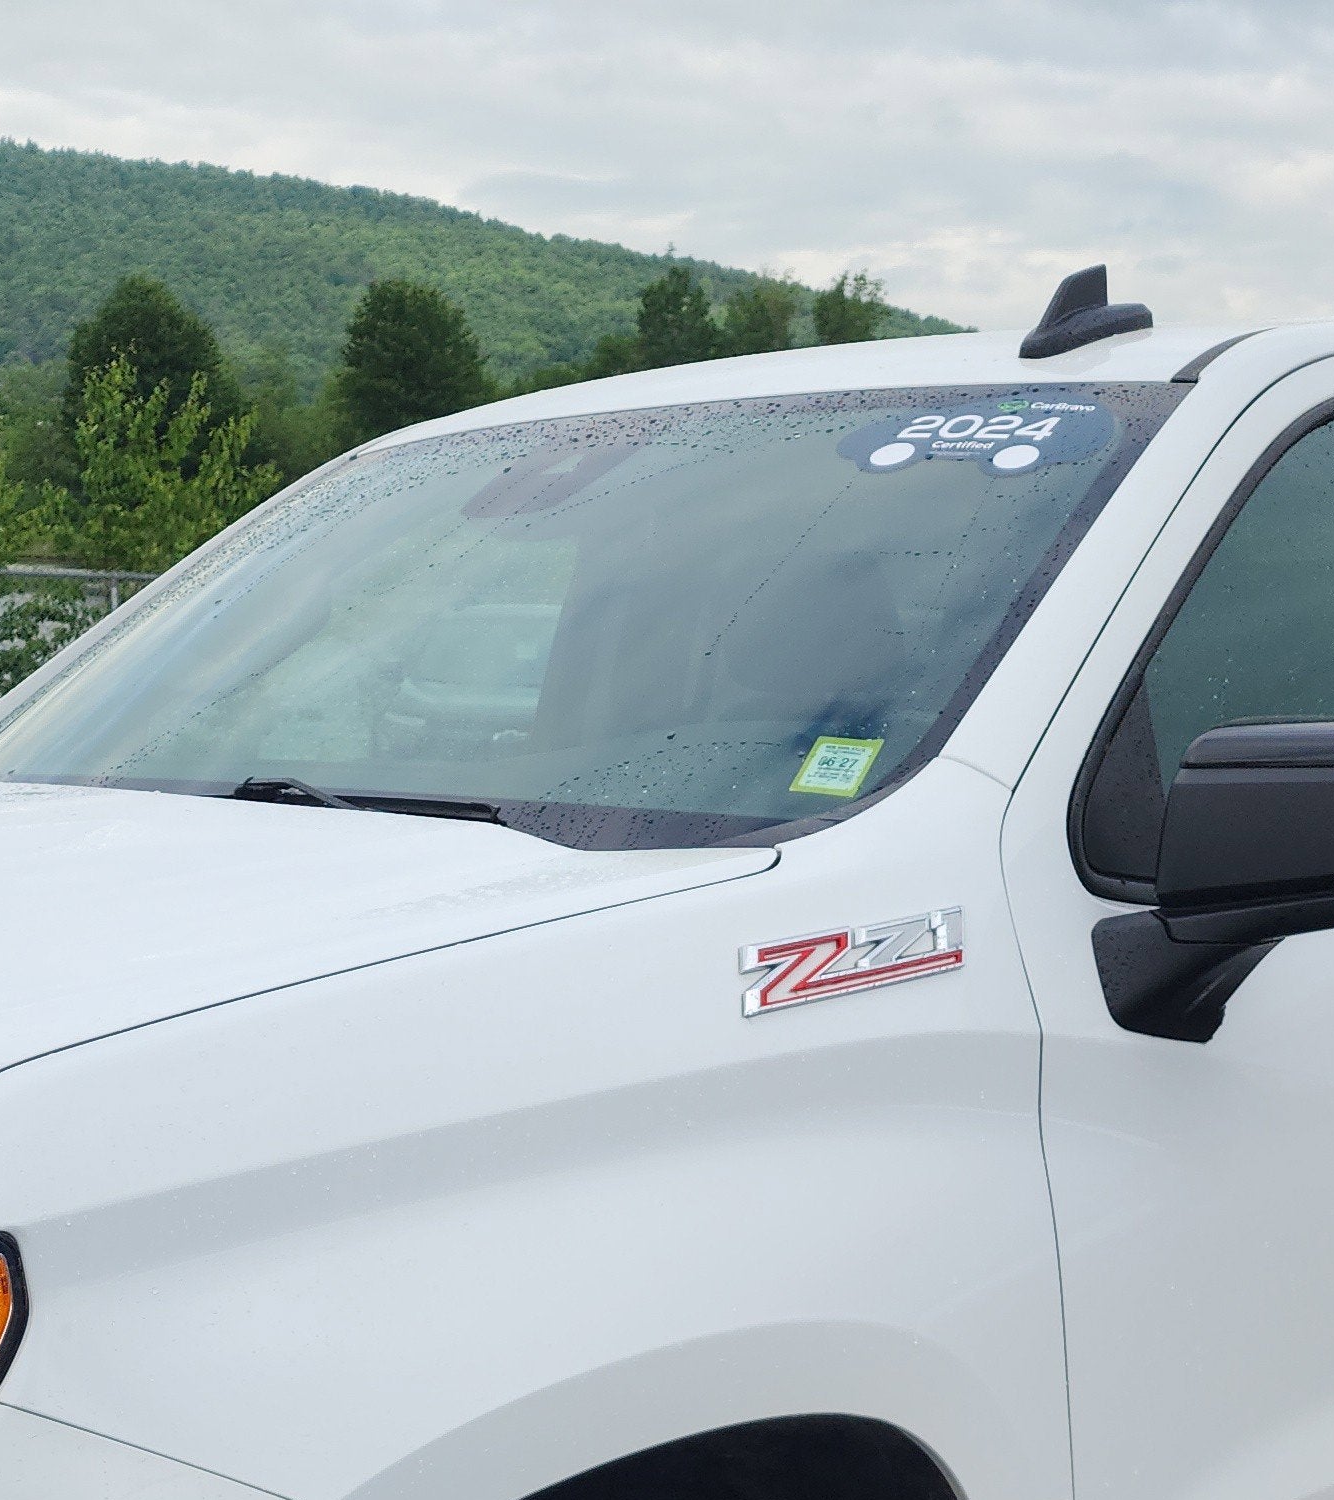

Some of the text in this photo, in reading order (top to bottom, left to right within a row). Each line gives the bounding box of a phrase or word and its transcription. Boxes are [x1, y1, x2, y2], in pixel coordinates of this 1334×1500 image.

[1030, 401, 1096, 412] CarBravo
[896, 414, 1061, 441] 2024
[931, 440, 995, 451] Certified
[738, 905, 965, 1018] Z71
